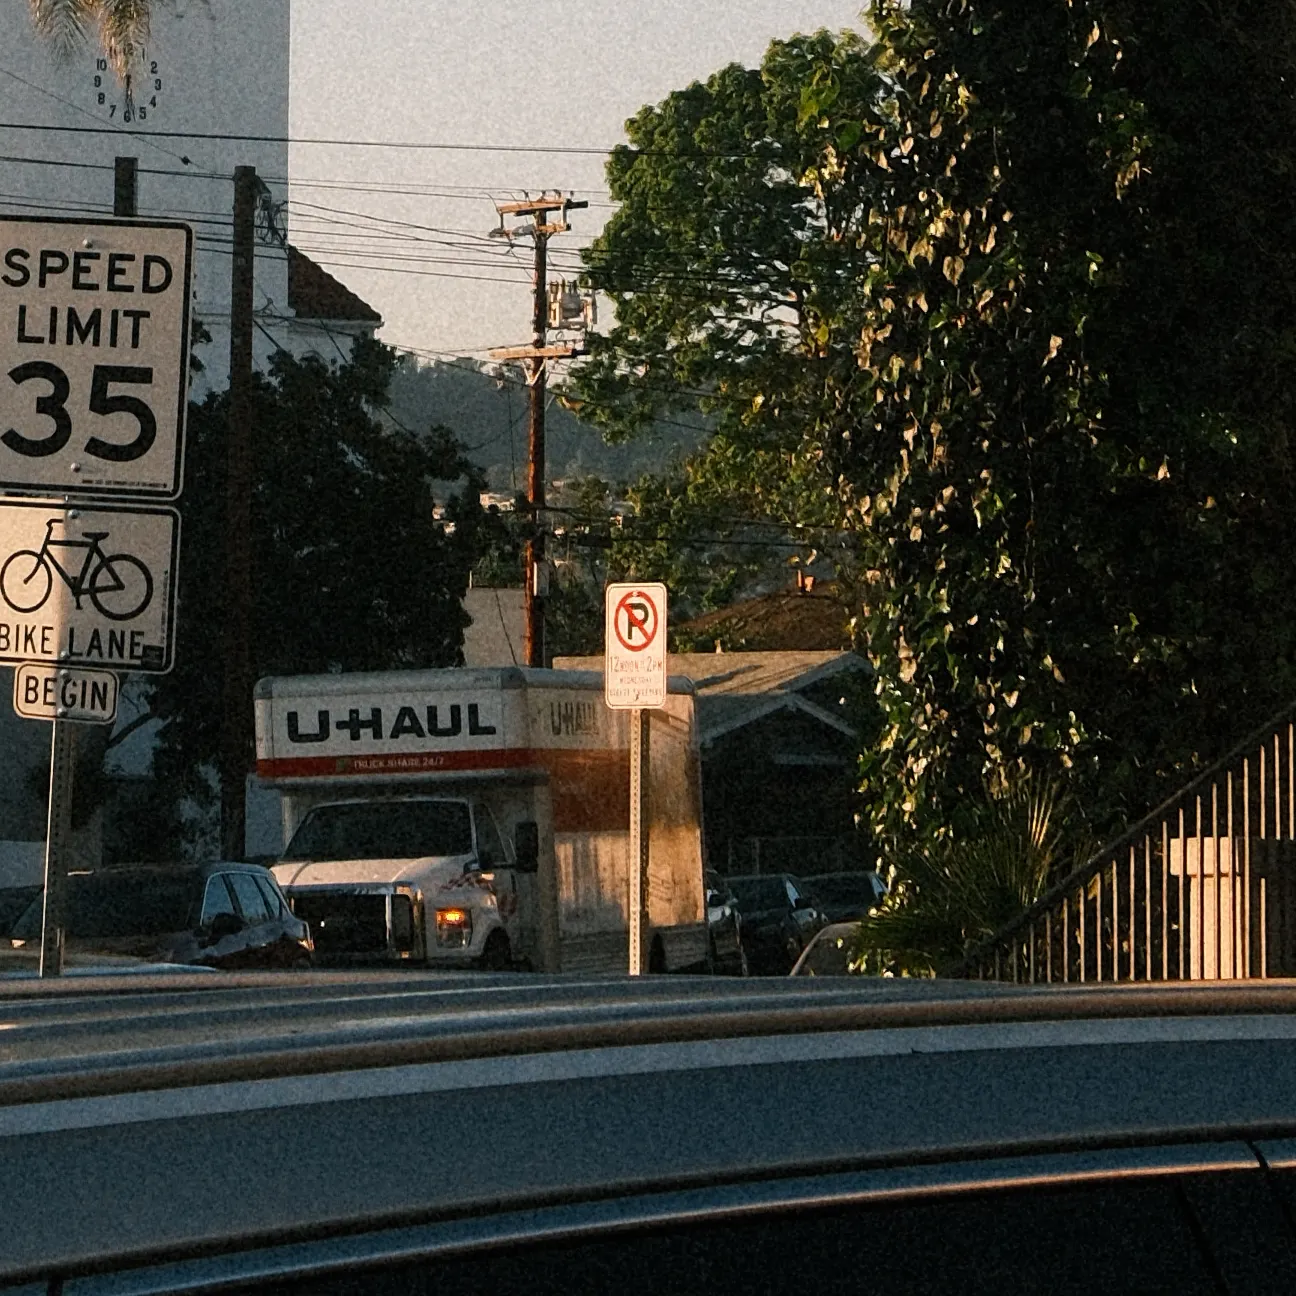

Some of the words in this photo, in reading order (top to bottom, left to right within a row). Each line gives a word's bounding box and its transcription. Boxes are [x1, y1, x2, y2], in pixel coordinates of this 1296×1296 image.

[97, 58, 107, 71] 10
[151, 61, 158, 74] 2
[94, 75, 101, 88] 9
[155, 79, 162, 91] 3
[98, 93, 105, 105] 8
[150, 96, 157, 108] 4
[110, 105, 117, 118] 7
[123, 110, 131, 123] 6
[139, 107, 147, 120] 5
[1, 248, 173, 294] SPEED
[17, 305, 151, 349] LIMIT
[0, 361, 157, 462] 35
[68, 627, 144, 660] LANE
[24, 675, 109, 712] BEGIN
[286, 703, 497, 744] U-HAUL
